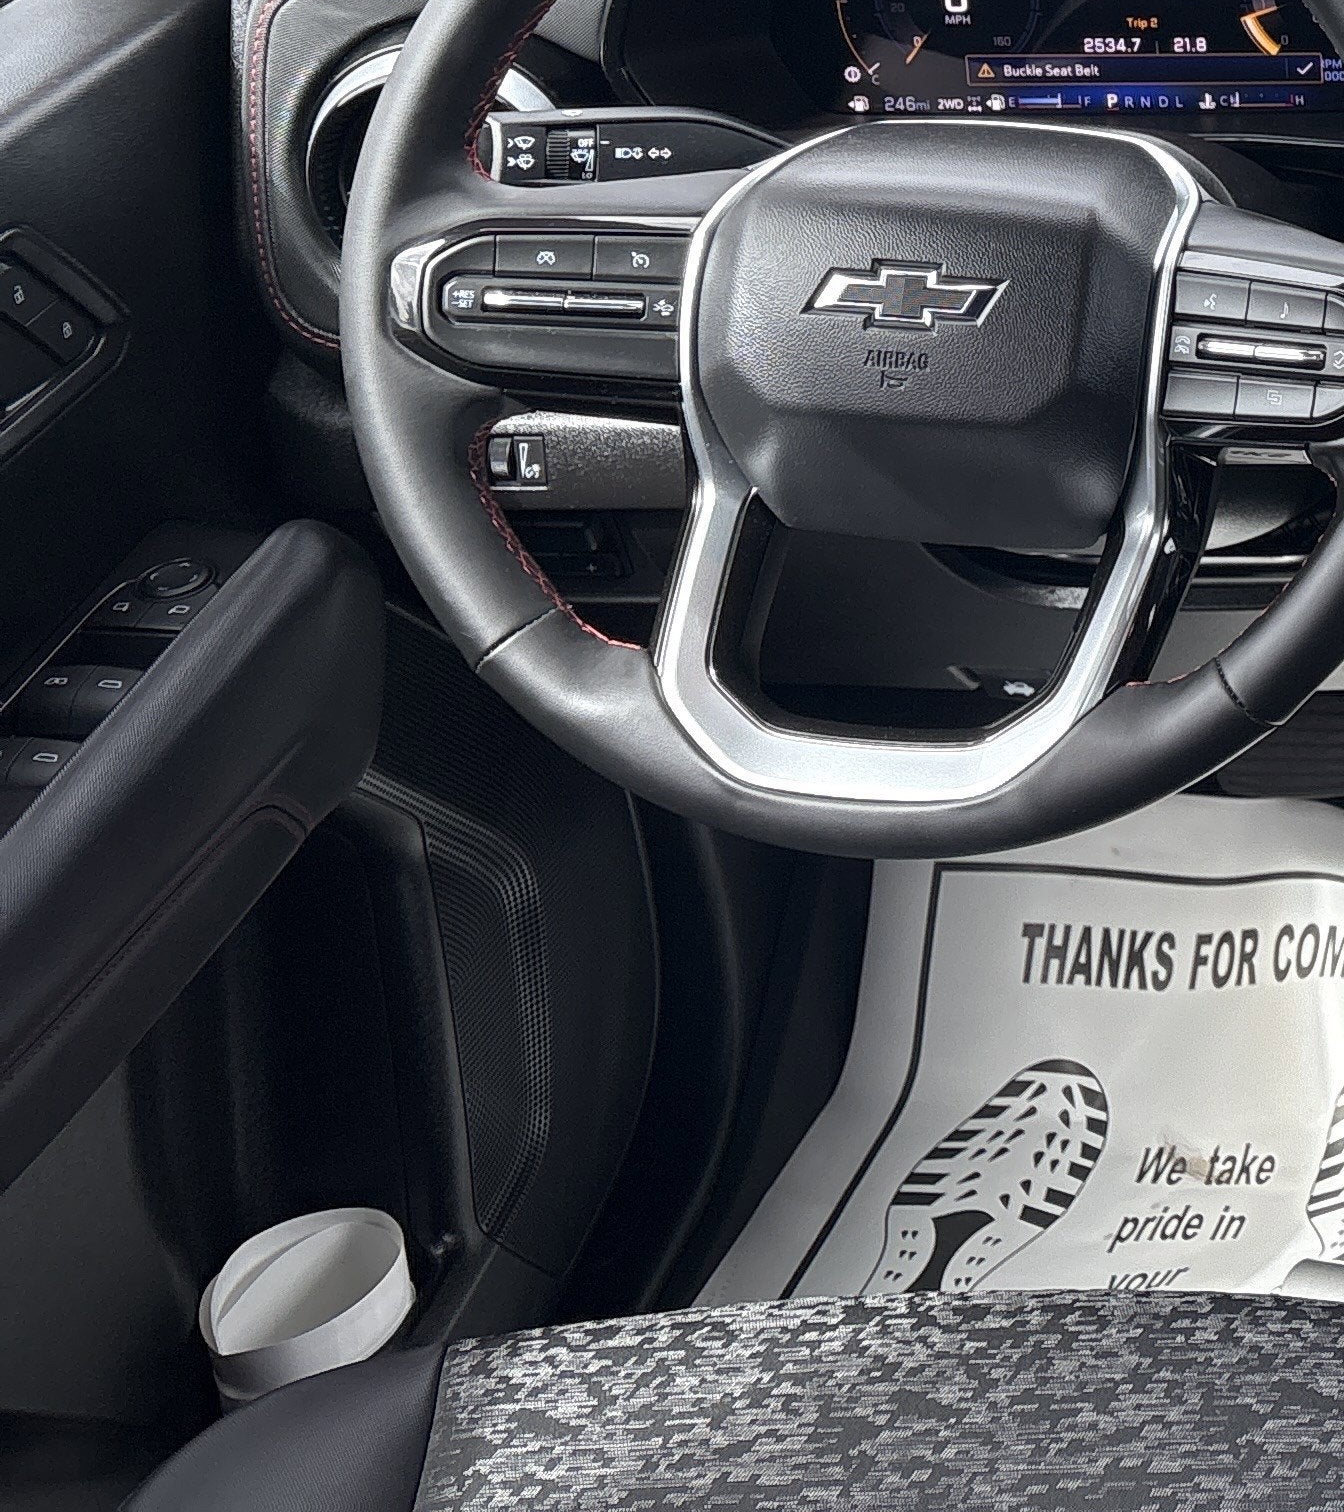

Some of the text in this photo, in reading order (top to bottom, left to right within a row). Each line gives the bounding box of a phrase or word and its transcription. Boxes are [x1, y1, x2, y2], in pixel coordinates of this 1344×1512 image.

[944, 15, 971, 25] MPH
[1126, 18, 1158, 31] Trip 2
[1083, 38, 1141, 53] 2534.7
[1173, 38, 1206, 53] 21.8
[1003, 64, 1099, 77] Buckle Seat Belt
[937, 99, 964, 110] 2WD
[1107, 93, 1183, 107] P R N D L
[578, 138, 594, 147] OFF
[863, 350, 930, 370] AIRBAG
[1021, 923, 1175, 991] THANKS
[1189, 928, 1258, 990] FOR
[1135, 1144, 1276, 1187] We take
[1107, 1207, 1247, 1252] pride in
